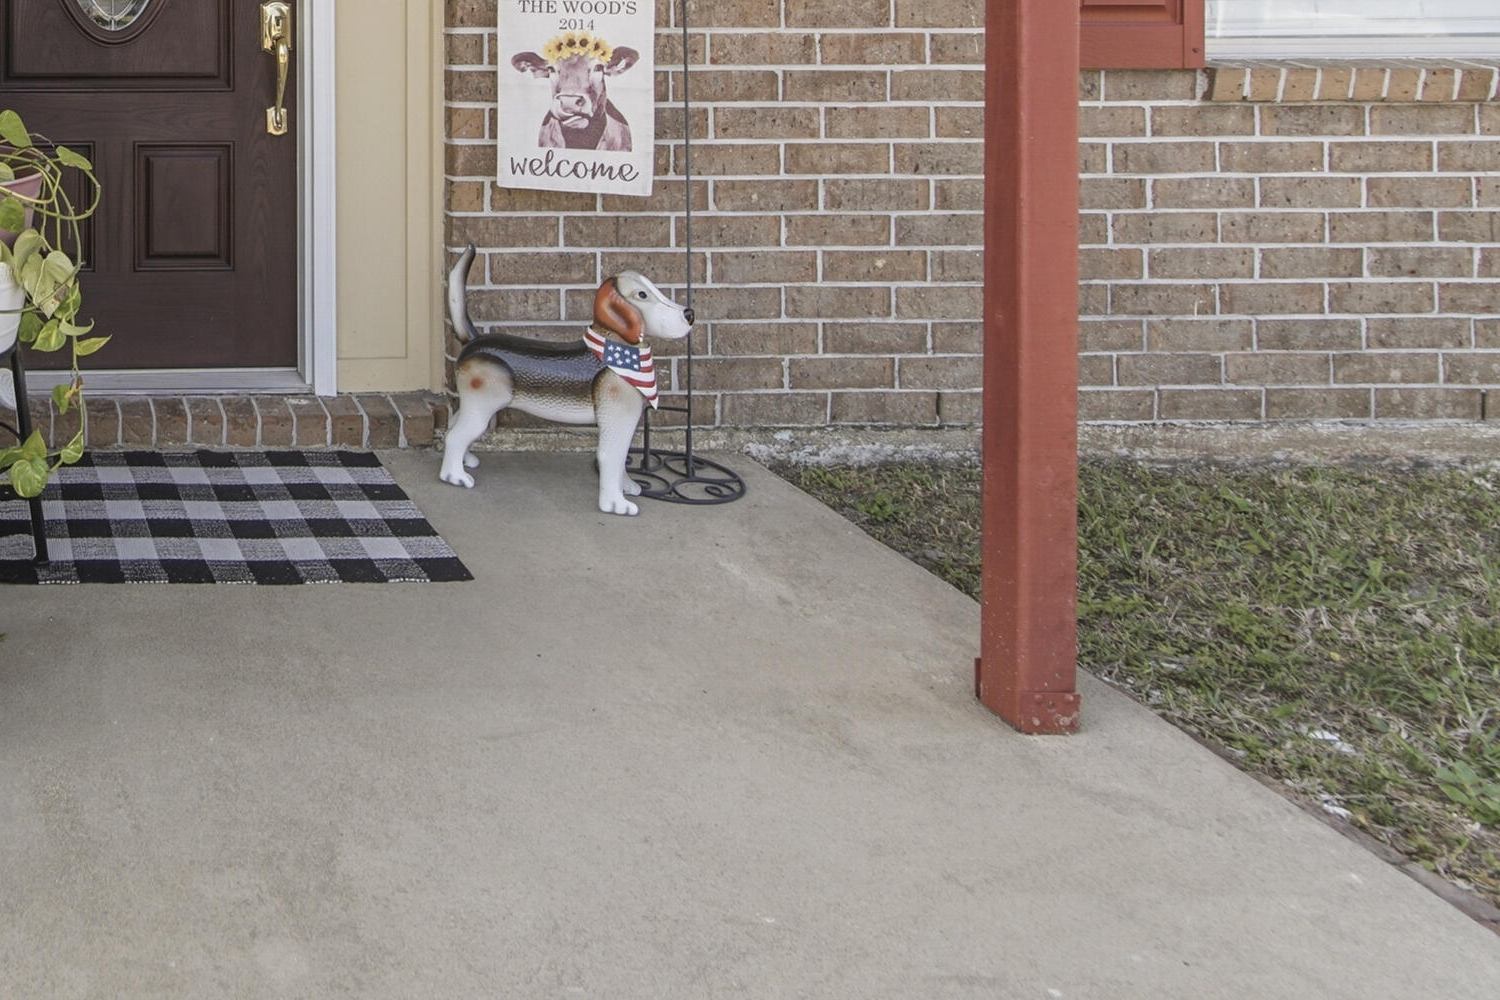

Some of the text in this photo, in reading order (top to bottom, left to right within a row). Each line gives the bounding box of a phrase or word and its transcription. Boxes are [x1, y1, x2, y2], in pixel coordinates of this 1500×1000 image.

[518, 0, 637, 15] THE WOOD'S
[558, 18, 595, 31] 2014
[510, 149, 640, 182] welcome
